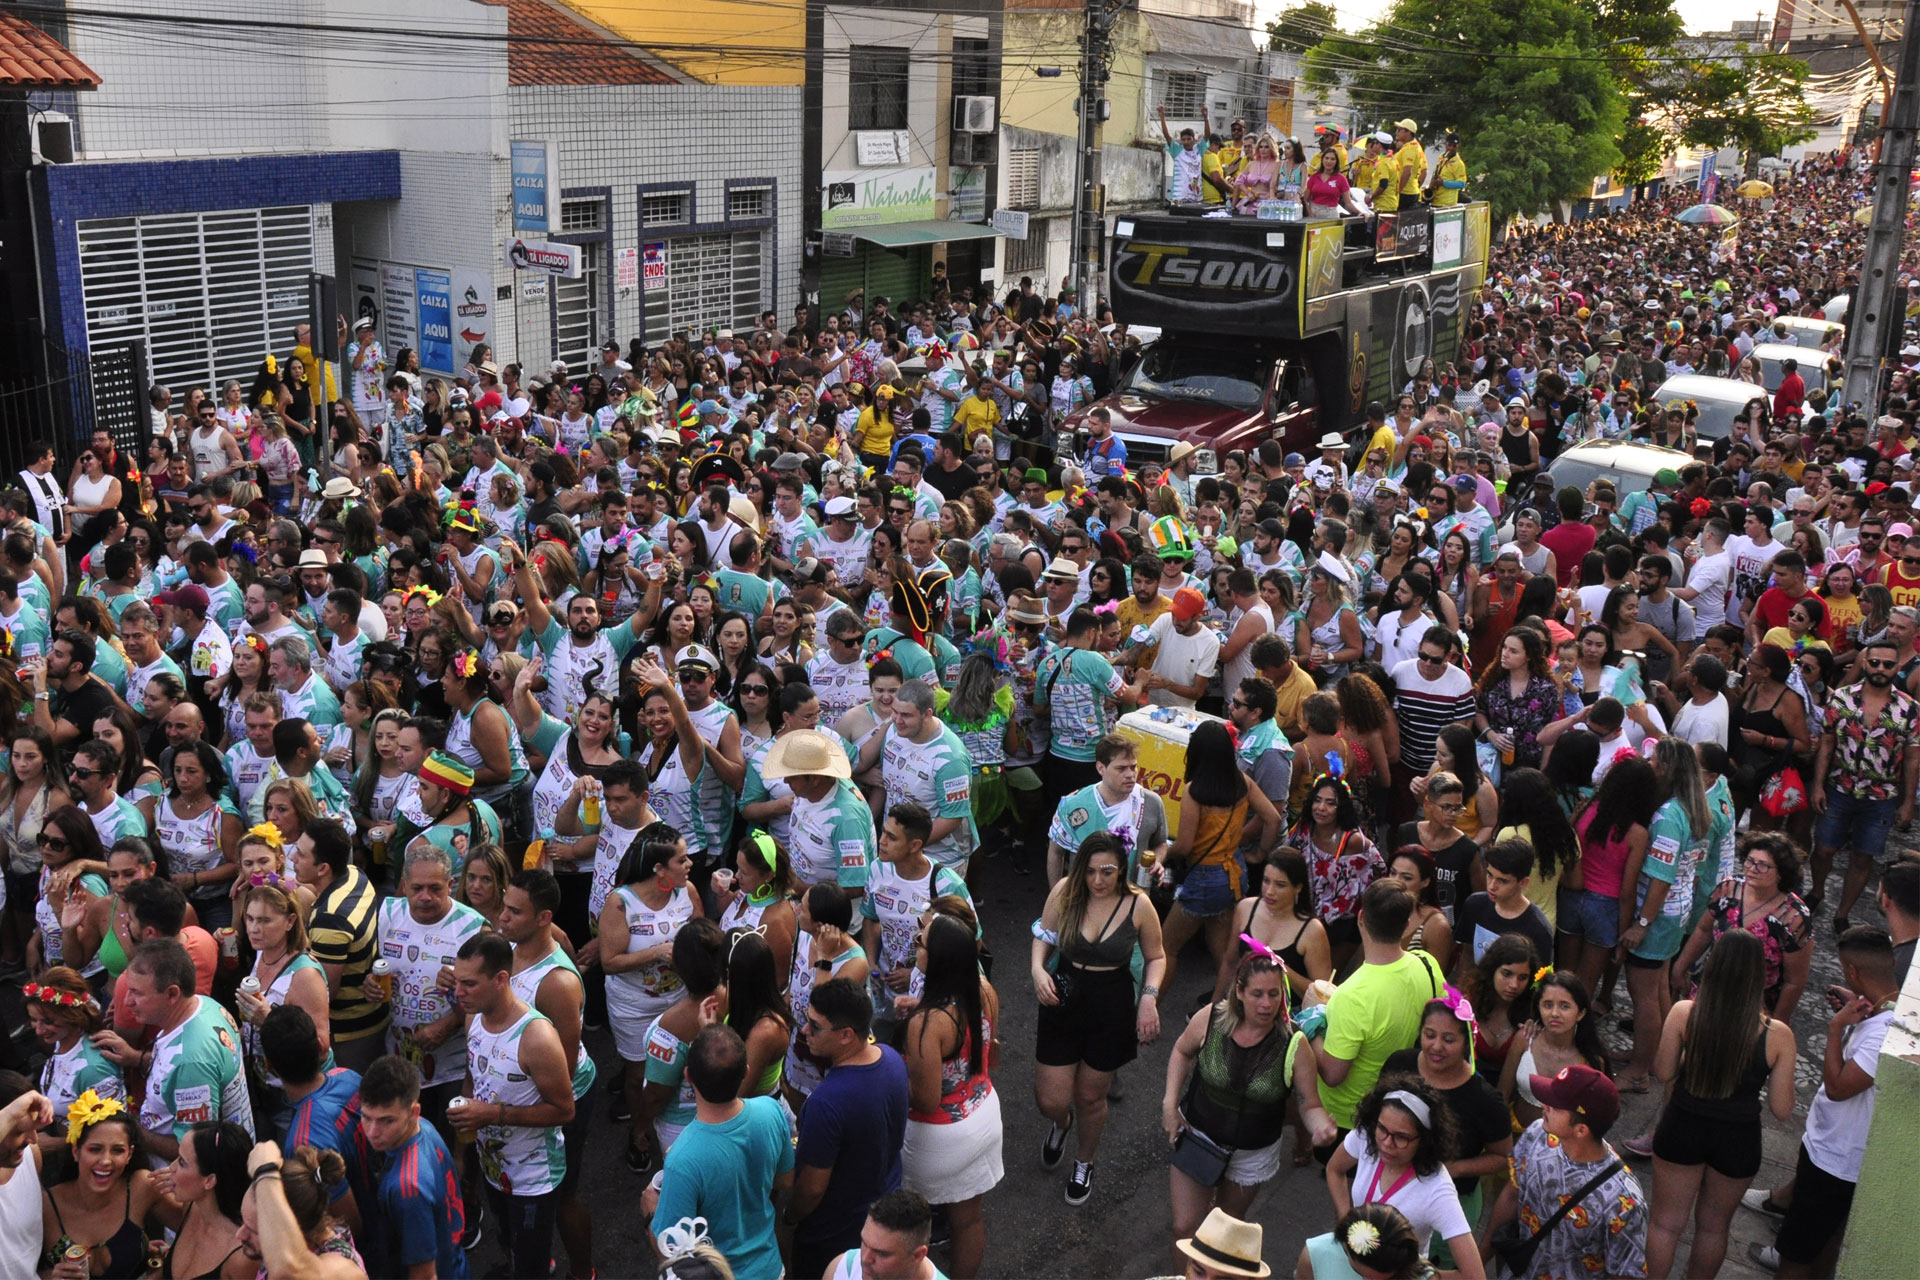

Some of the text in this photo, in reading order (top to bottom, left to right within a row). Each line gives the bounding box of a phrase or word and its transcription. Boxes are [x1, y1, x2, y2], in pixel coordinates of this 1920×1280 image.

[515, 177, 544, 189] CAIXA
[518, 203, 544, 217] AQUI
[1400, 225, 1415, 240] AQUI
[644, 263, 665, 278] ENDE
[1126, 243, 1286, 292] TSOM
[524, 286, 545, 296] VENDE
[420, 294, 448, 309] CAIXA
[424, 322, 449, 338] AQUI
[1829, 607, 1859, 618] UEEN
[833, 701, 847, 709] OS
[1136, 766, 1182, 802] KOL
[1435, 866, 1459, 882] ORK
[897, 928, 910, 939] OS
[404, 982, 420, 997] OS
[402, 1007, 441, 1021] FERRO
[177, 1103, 210, 1123] PITÚ
